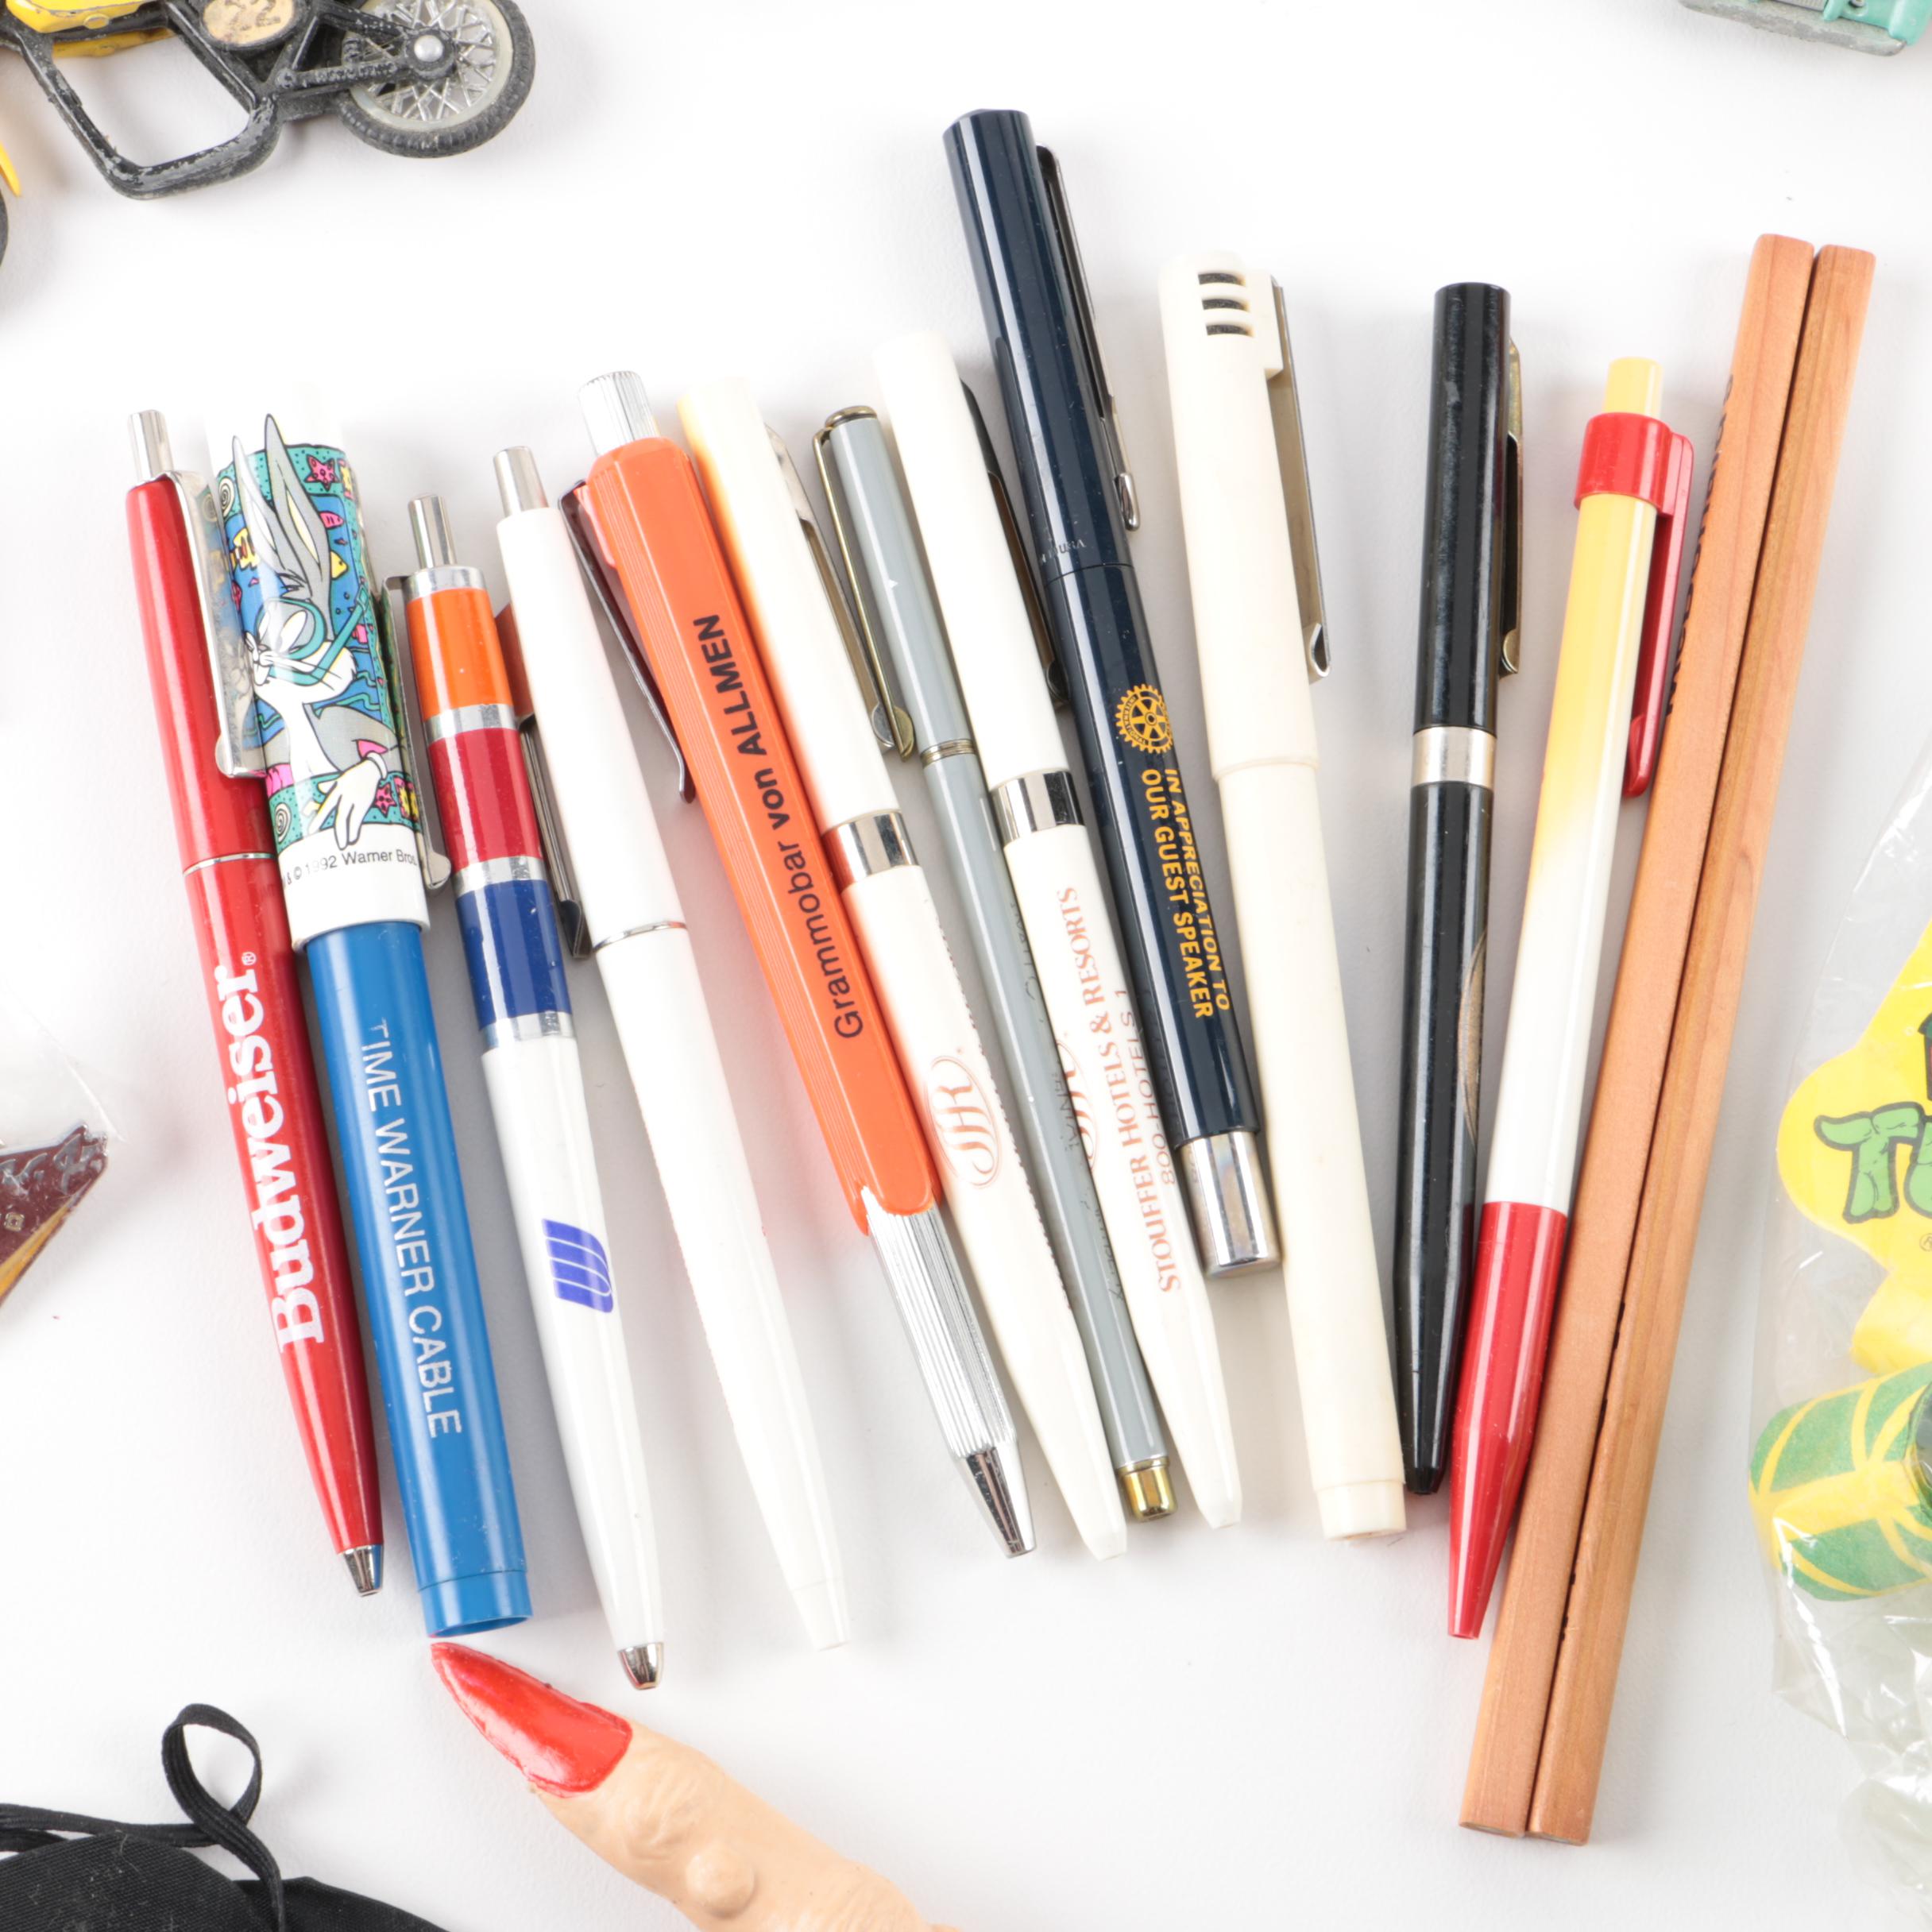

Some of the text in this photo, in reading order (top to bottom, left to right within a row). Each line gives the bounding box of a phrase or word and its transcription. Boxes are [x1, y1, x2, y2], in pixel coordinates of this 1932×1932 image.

[342, 850, 392, 866] Warner
[693, 614, 864, 1038] Grammobar von ALLMEN
[1141, 769, 1214, 1018] OUR GUEST SPEAKER
[1165, 768, 1230, 1010] IN APPRECIATION TO
[1057, 887, 1105, 1007] RESORTS
[1090, 1013, 1114, 1034] &
[1098, 1039, 1142, 1149] HOTELS
[362, 1017, 462, 1439] TIME WARNER CABLE
[1130, 1156, 1181, 1293] STOUFFER
